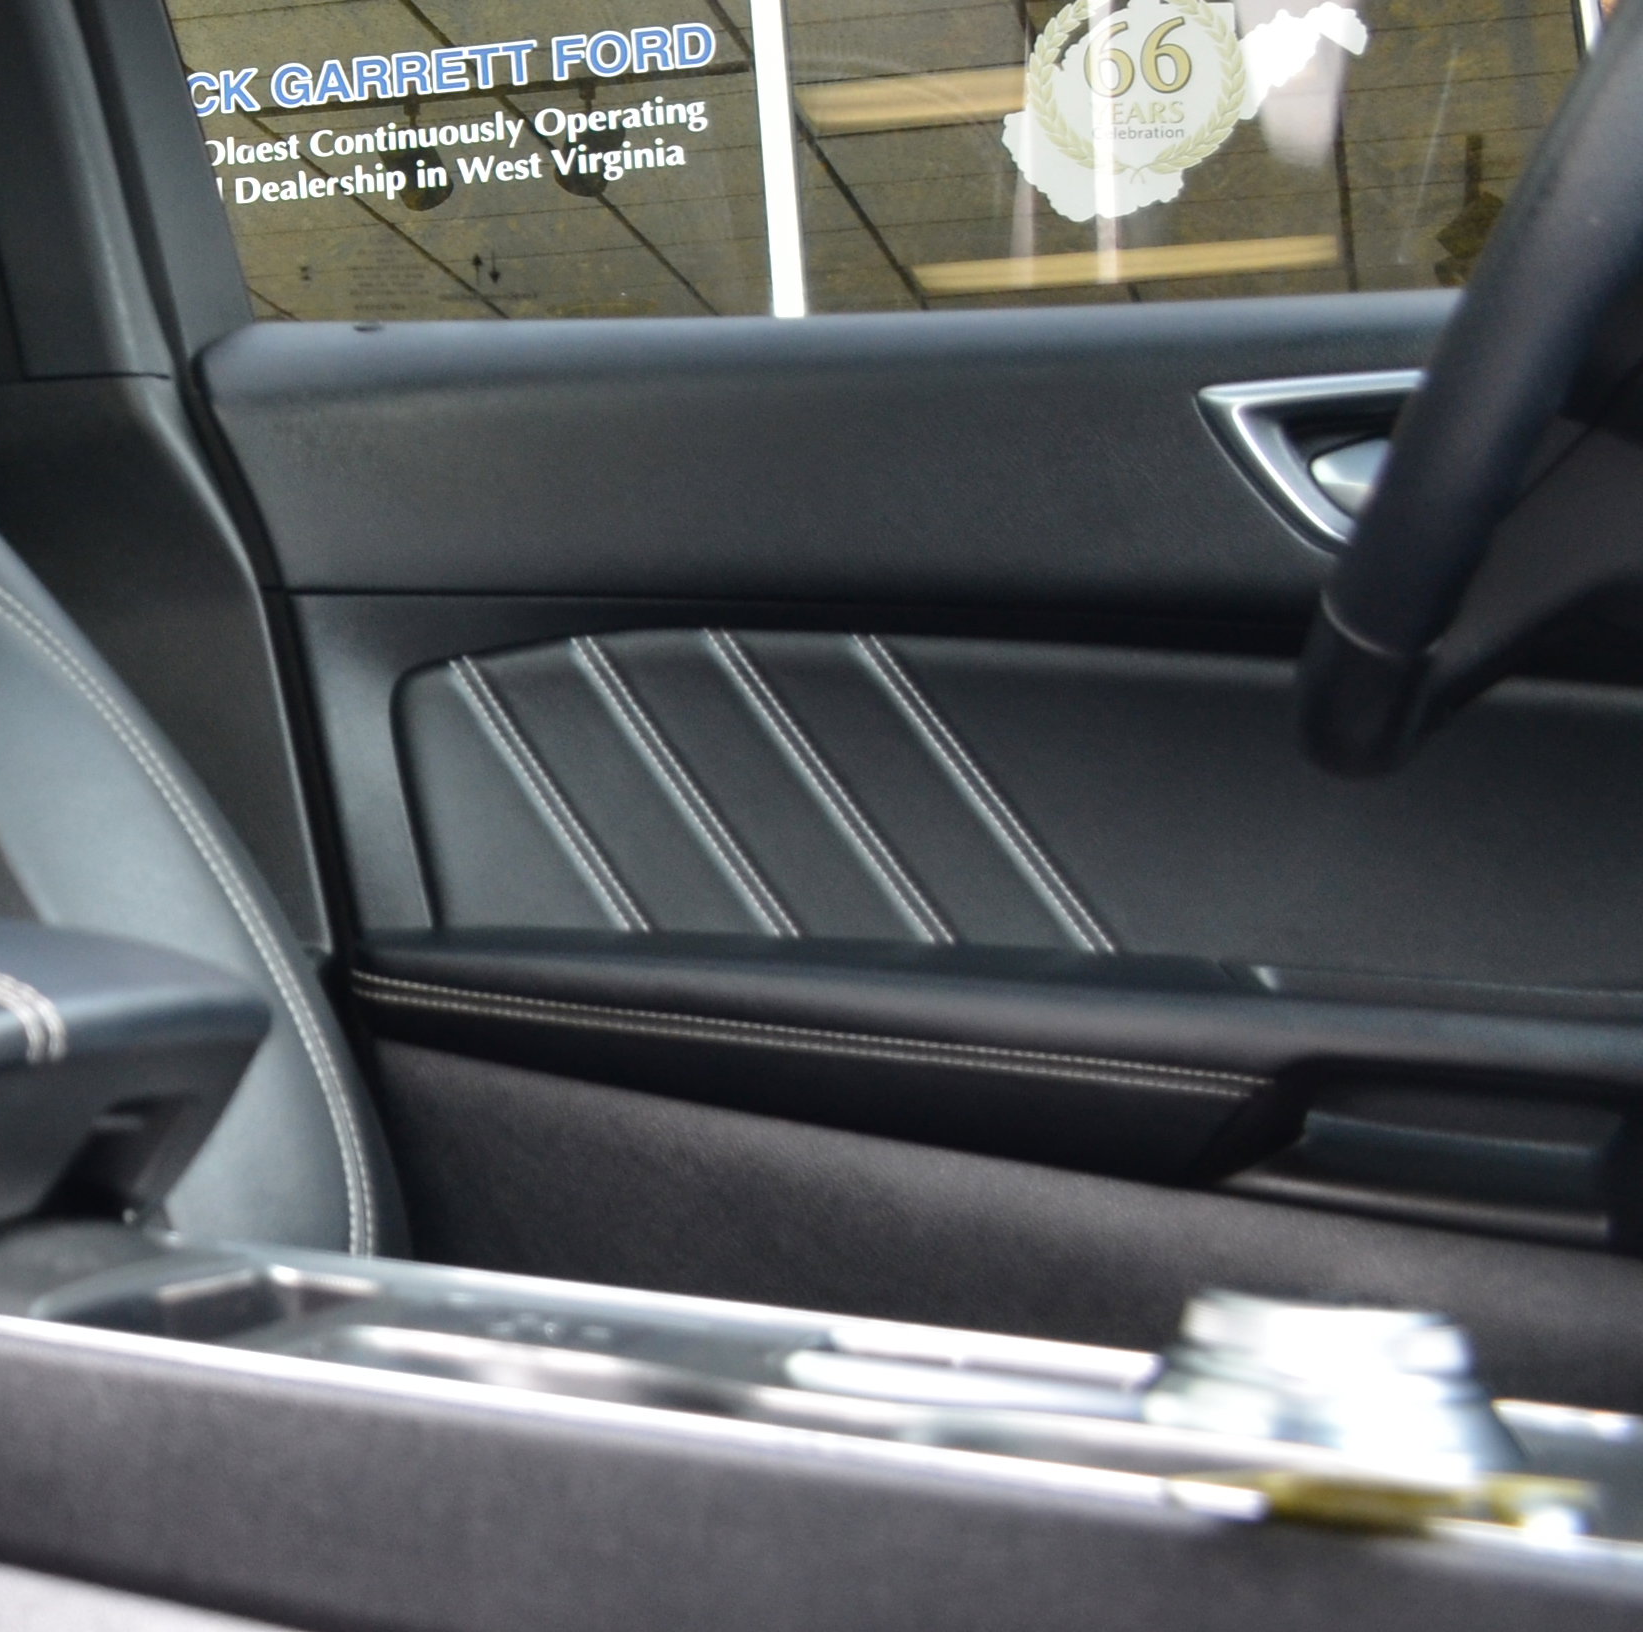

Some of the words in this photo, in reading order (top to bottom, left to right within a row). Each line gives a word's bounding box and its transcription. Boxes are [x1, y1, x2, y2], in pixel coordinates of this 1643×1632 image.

[271, 39, 537, 109] GARRETT
[552, 23, 715, 81] FORD
[1083, 16, 1192, 98] 66
[310, 111, 524, 157] Continuously
[534, 96, 708, 142] Operating
[1092, 126, 1185, 141] Clebration
[235, 163, 406, 204] Dealership
[416, 160, 447, 188] in
[457, 153, 543, 184] West
[551, 138, 686, 181] Virginia
